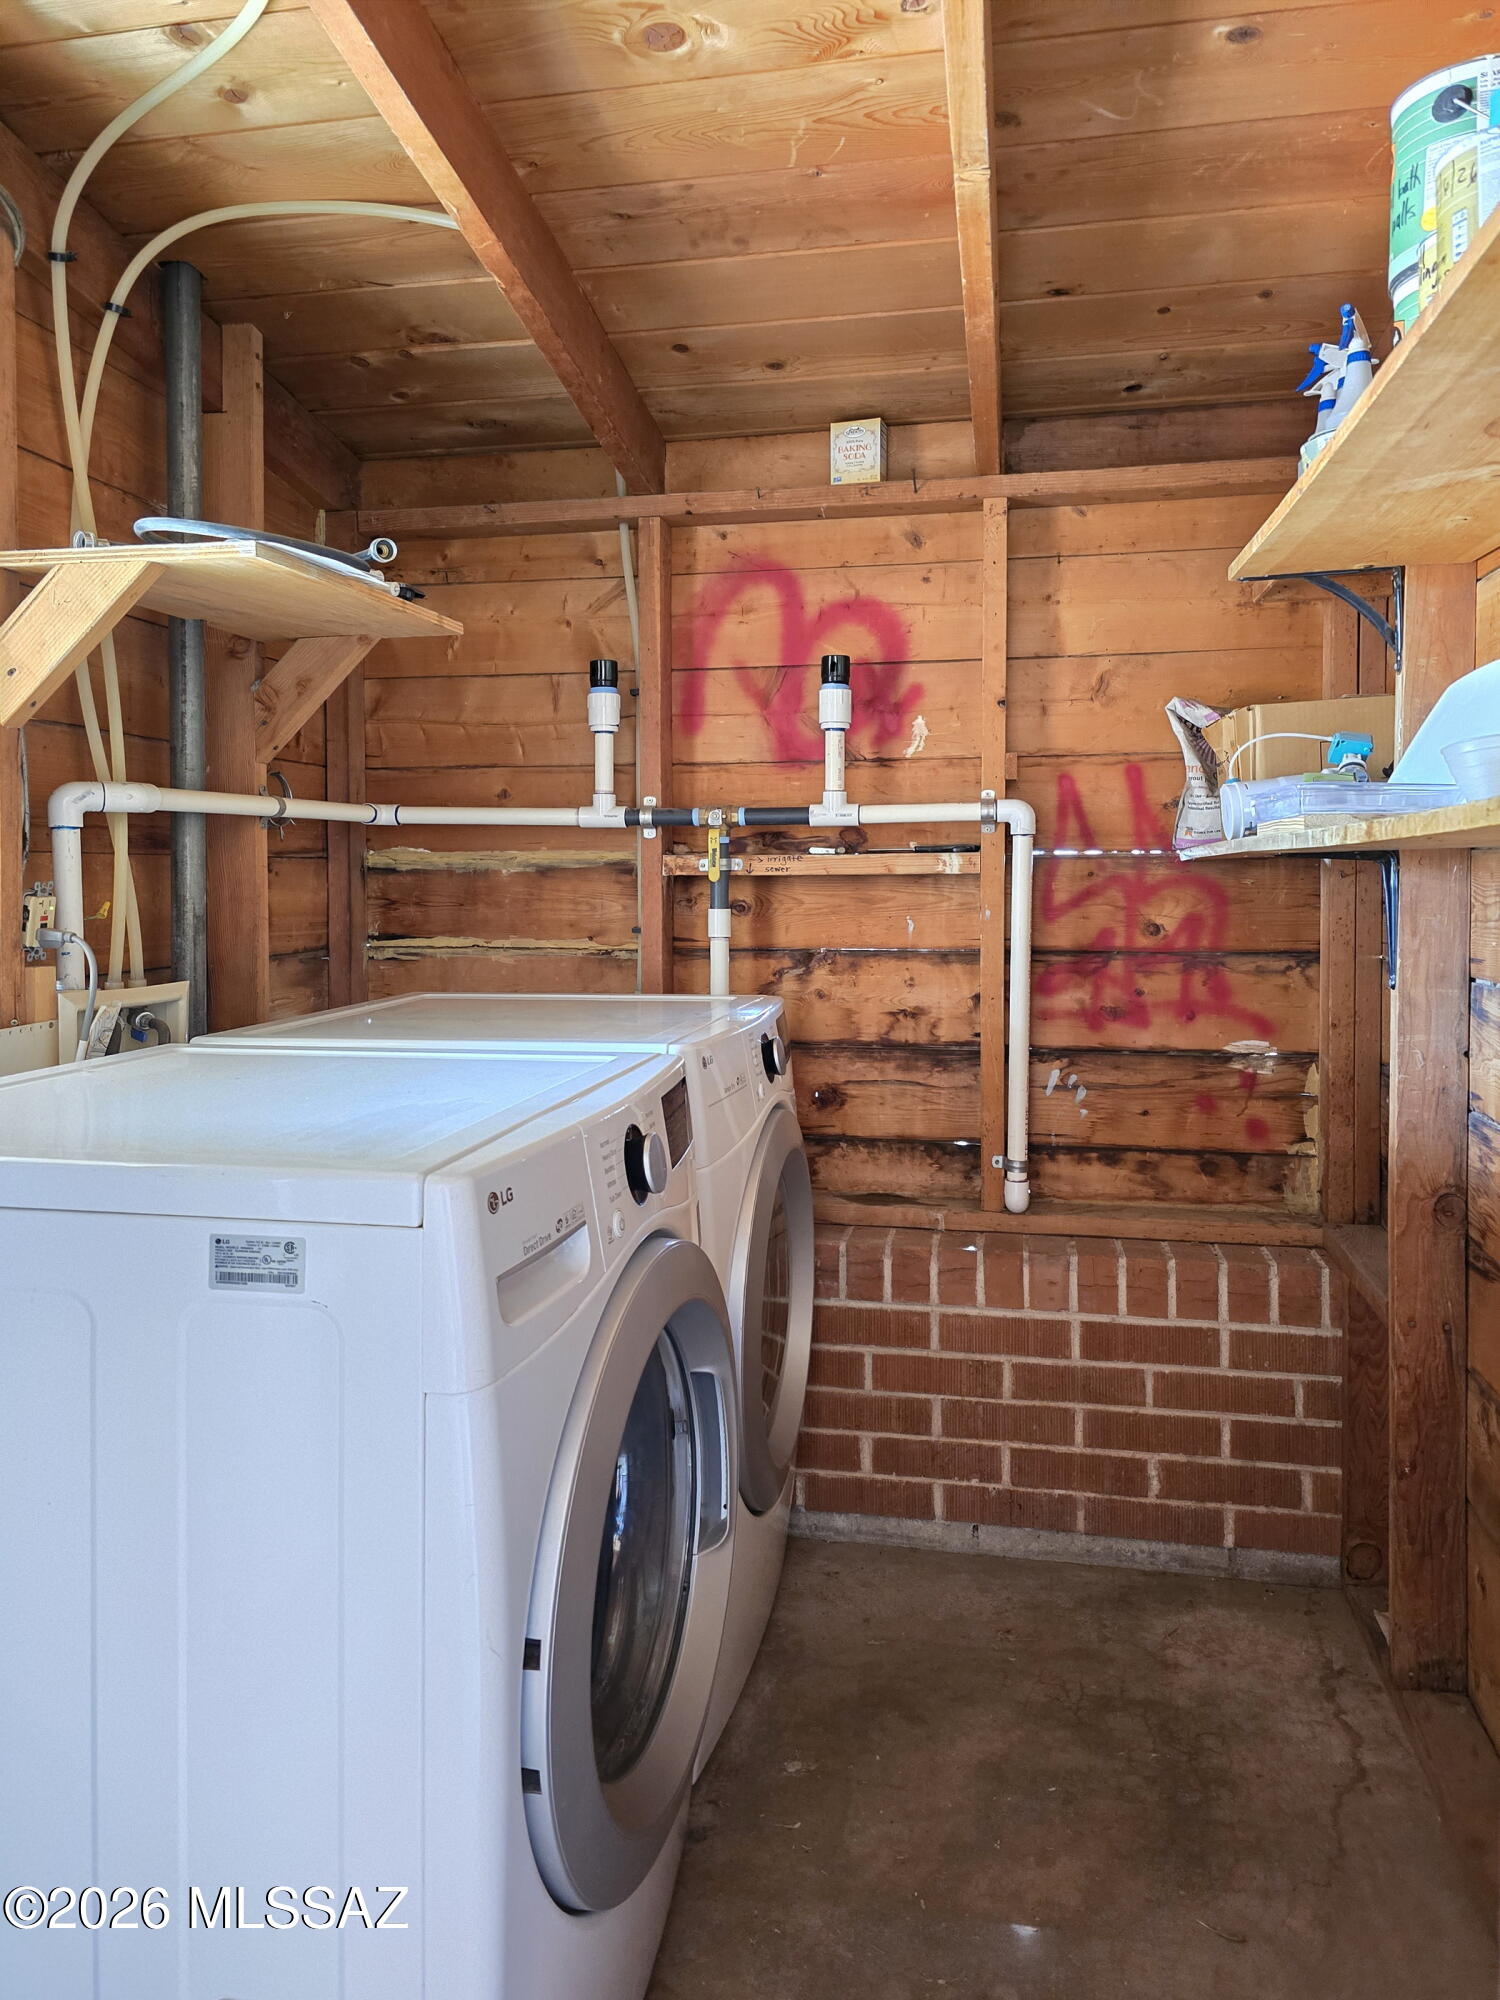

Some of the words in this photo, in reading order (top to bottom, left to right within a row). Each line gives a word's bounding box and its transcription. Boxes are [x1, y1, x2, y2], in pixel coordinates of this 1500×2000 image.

[1398, 162, 1421, 200] bath
[837, 443, 872, 454] BAKING
[843, 452, 866, 461] SODA
[767, 854, 804, 866] irrigate
[706, 1055, 714, 1066] LG
[500, 1187, 514, 1206] LG
[523, 1241, 540, 1256] Direct
[540, 1233, 552, 1247] Drive
